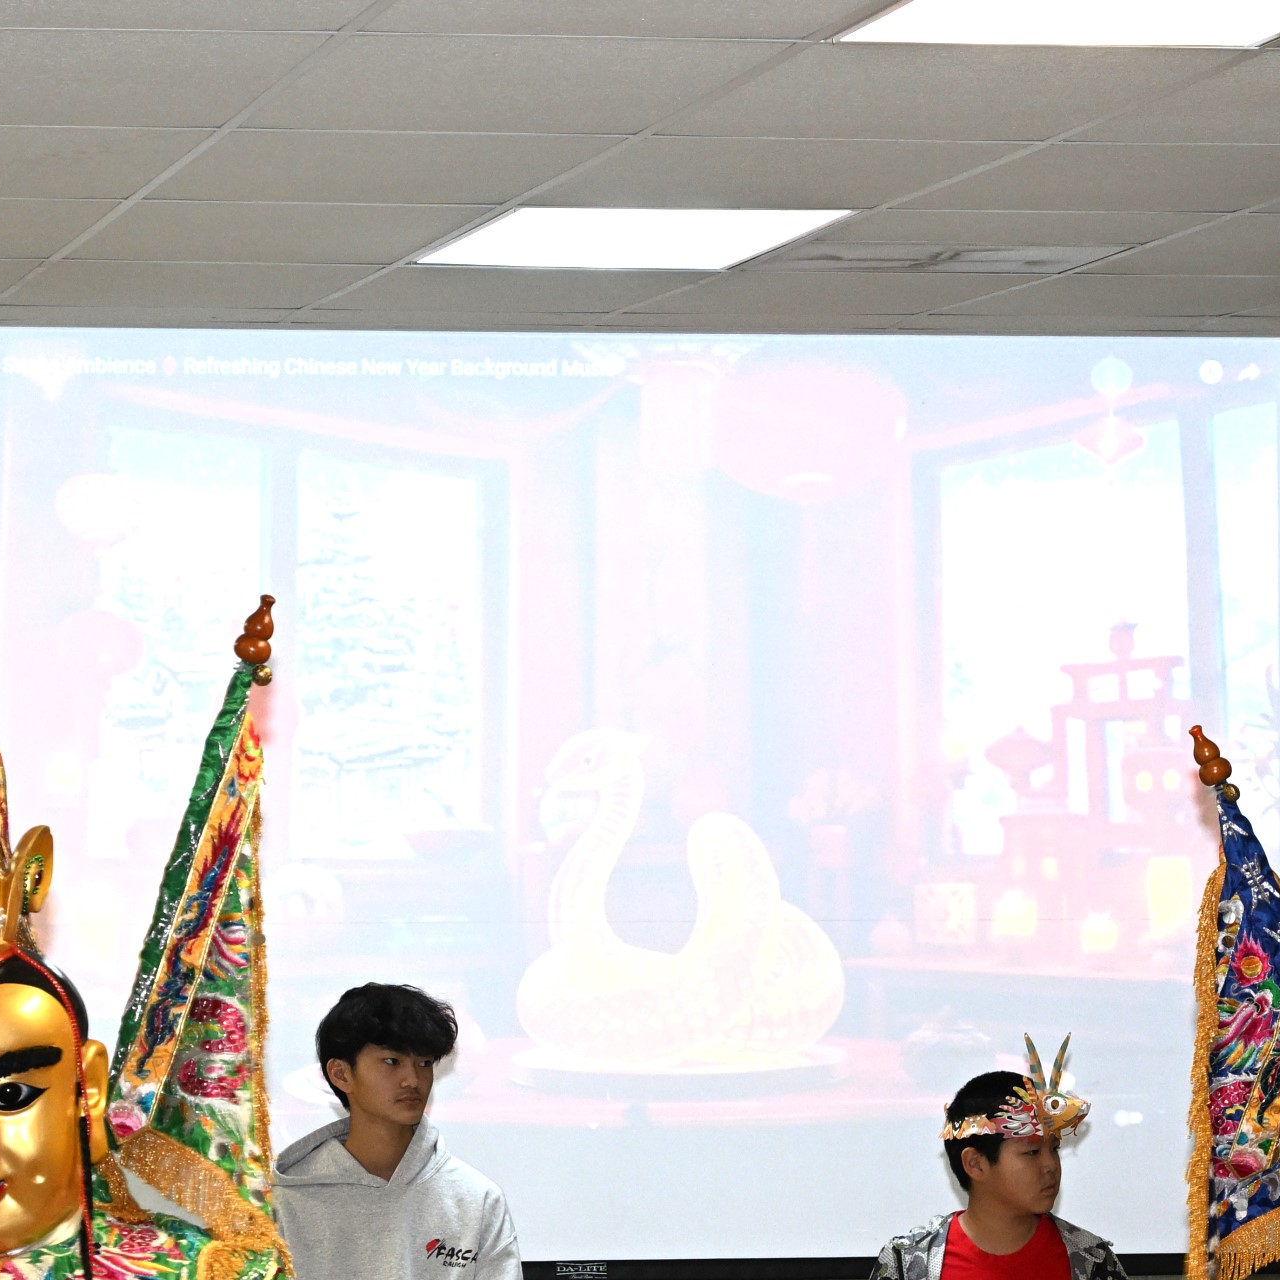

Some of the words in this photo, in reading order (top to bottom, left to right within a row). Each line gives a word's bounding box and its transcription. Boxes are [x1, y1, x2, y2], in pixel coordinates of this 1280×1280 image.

[183, 357, 281, 379] Refreshing
[284, 358, 359, 376] Chinese
[362, 359, 403, 376] New
[406, 359, 448, 377] Year
[451, 358, 557, 380] Background
[561, 359, 617, 377] Mus
